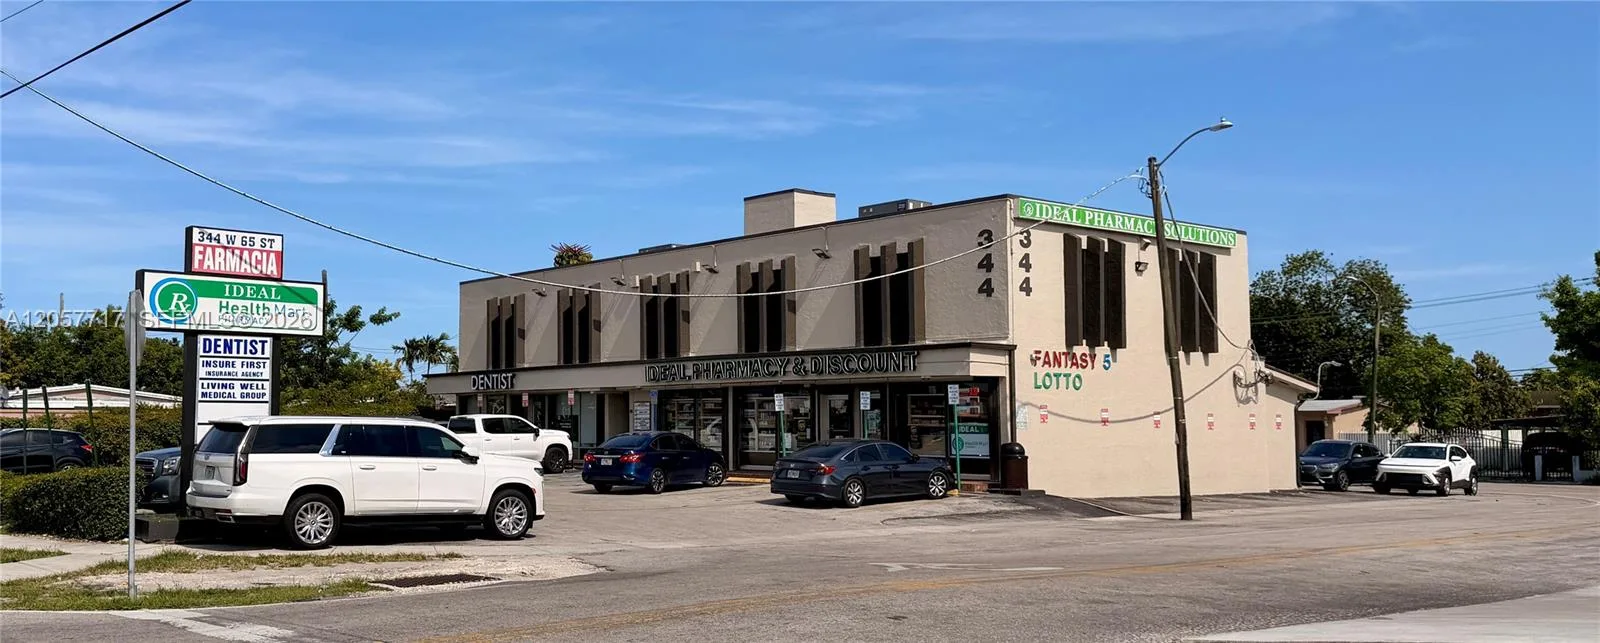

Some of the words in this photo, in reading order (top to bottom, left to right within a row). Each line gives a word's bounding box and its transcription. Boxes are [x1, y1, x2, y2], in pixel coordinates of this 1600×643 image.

[1035, 203, 1081, 223] IDEAL
[1085, 210, 1157, 233] PHARMAC
[1164, 222, 1235, 246] SOLUTIONS
[198, 231, 221, 244] 344
[226, 234, 236, 245] W
[241, 236, 255, 247] 65
[260, 238, 275, 249] ST
[193, 245, 278, 276] FARMACIA
[224, 284, 281, 300] IDEAL
[219, 300, 270, 317] Health
[274, 303, 307, 318] Mart
[202, 338, 268, 355] DENTIST
[202, 360, 237, 369] INSURE
[241, 361, 267, 369] FIRST
[645, 363, 689, 382] IDEAL
[692, 357, 790, 381] PHARMACY
[792, 356, 807, 376] &
[810, 351, 917, 375] DISCOUNT
[1031, 349, 1097, 370] FANTASY
[1102, 353, 1111, 371] 5
[201, 382, 235, 390] LIVING
[240, 383, 266, 391] WELL
[471, 373, 513, 390] DENTIST
[1033, 372, 1083, 391] LOTTO
[201, 391, 237, 399] MEDICAL
